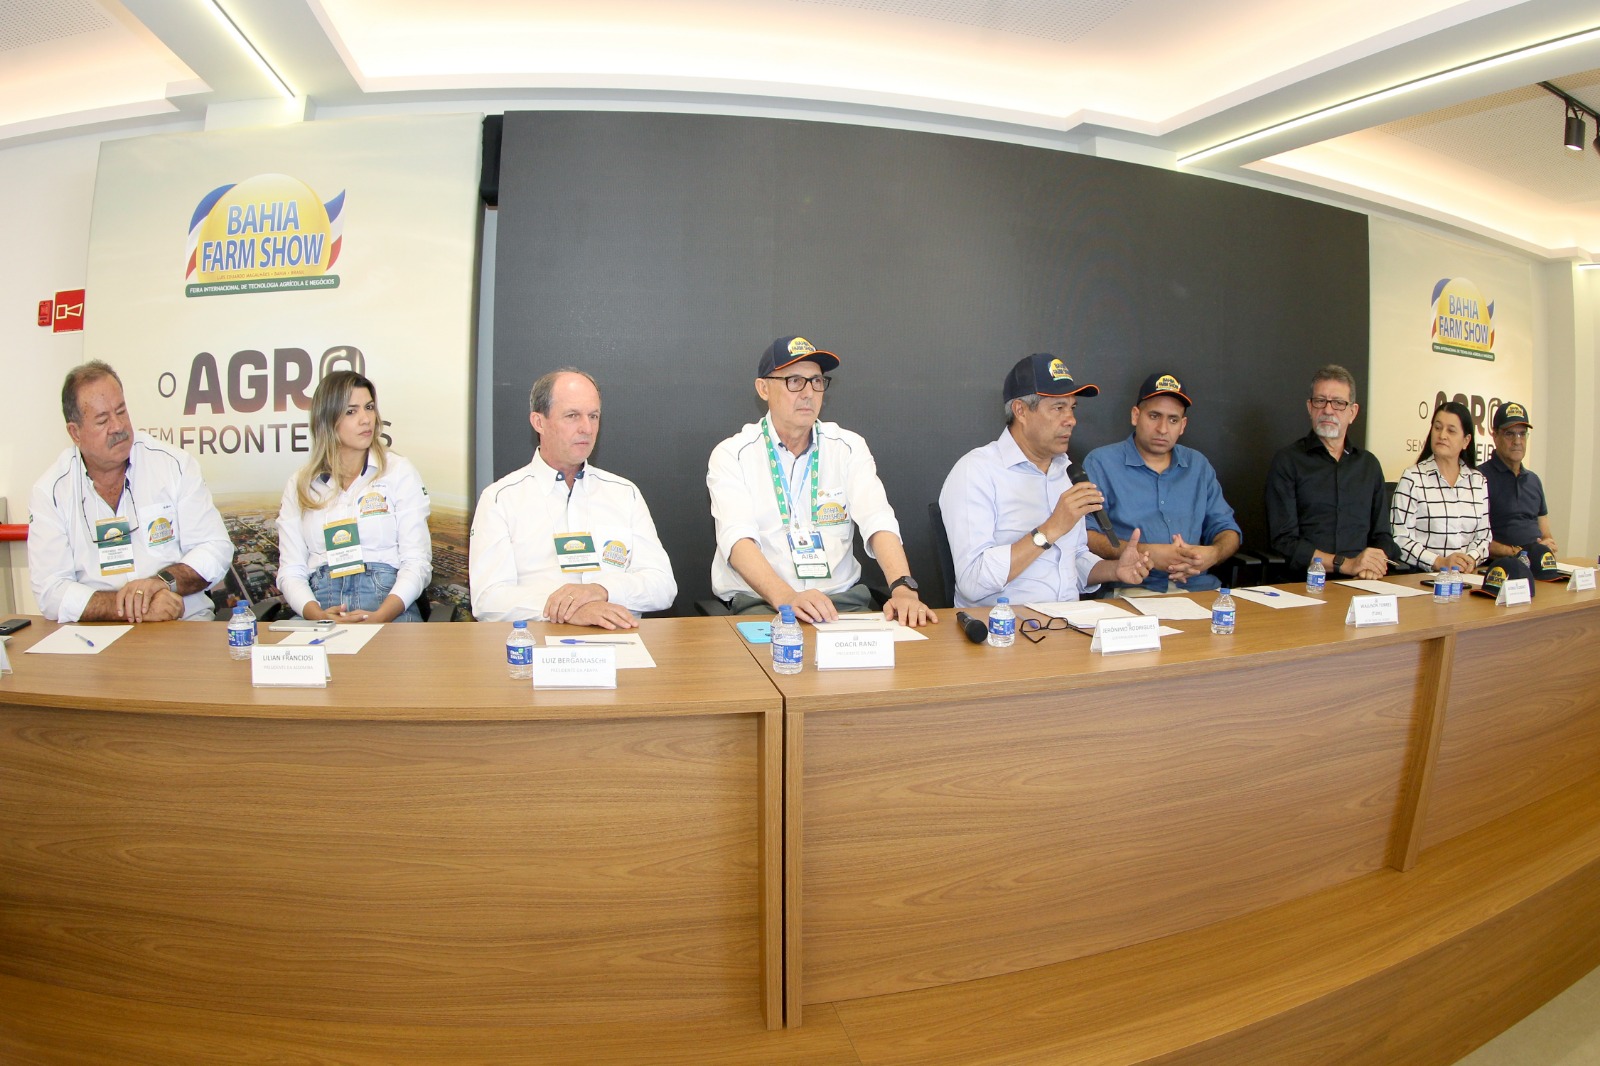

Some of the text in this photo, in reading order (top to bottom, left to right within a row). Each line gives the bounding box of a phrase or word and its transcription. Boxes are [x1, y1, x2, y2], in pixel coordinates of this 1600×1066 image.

[228, 201, 300, 235] BAHIA
[202, 234, 325, 272] FARM SHOW
[1449, 294, 1479, 320] BAHIA
[1439, 315, 1463, 340] FARM
[1464, 321, 1489, 345] SHOW
[158, 372, 177, 398] O
[1419, 401, 1428, 419] O
[180, 420, 393, 455] FRONTES
